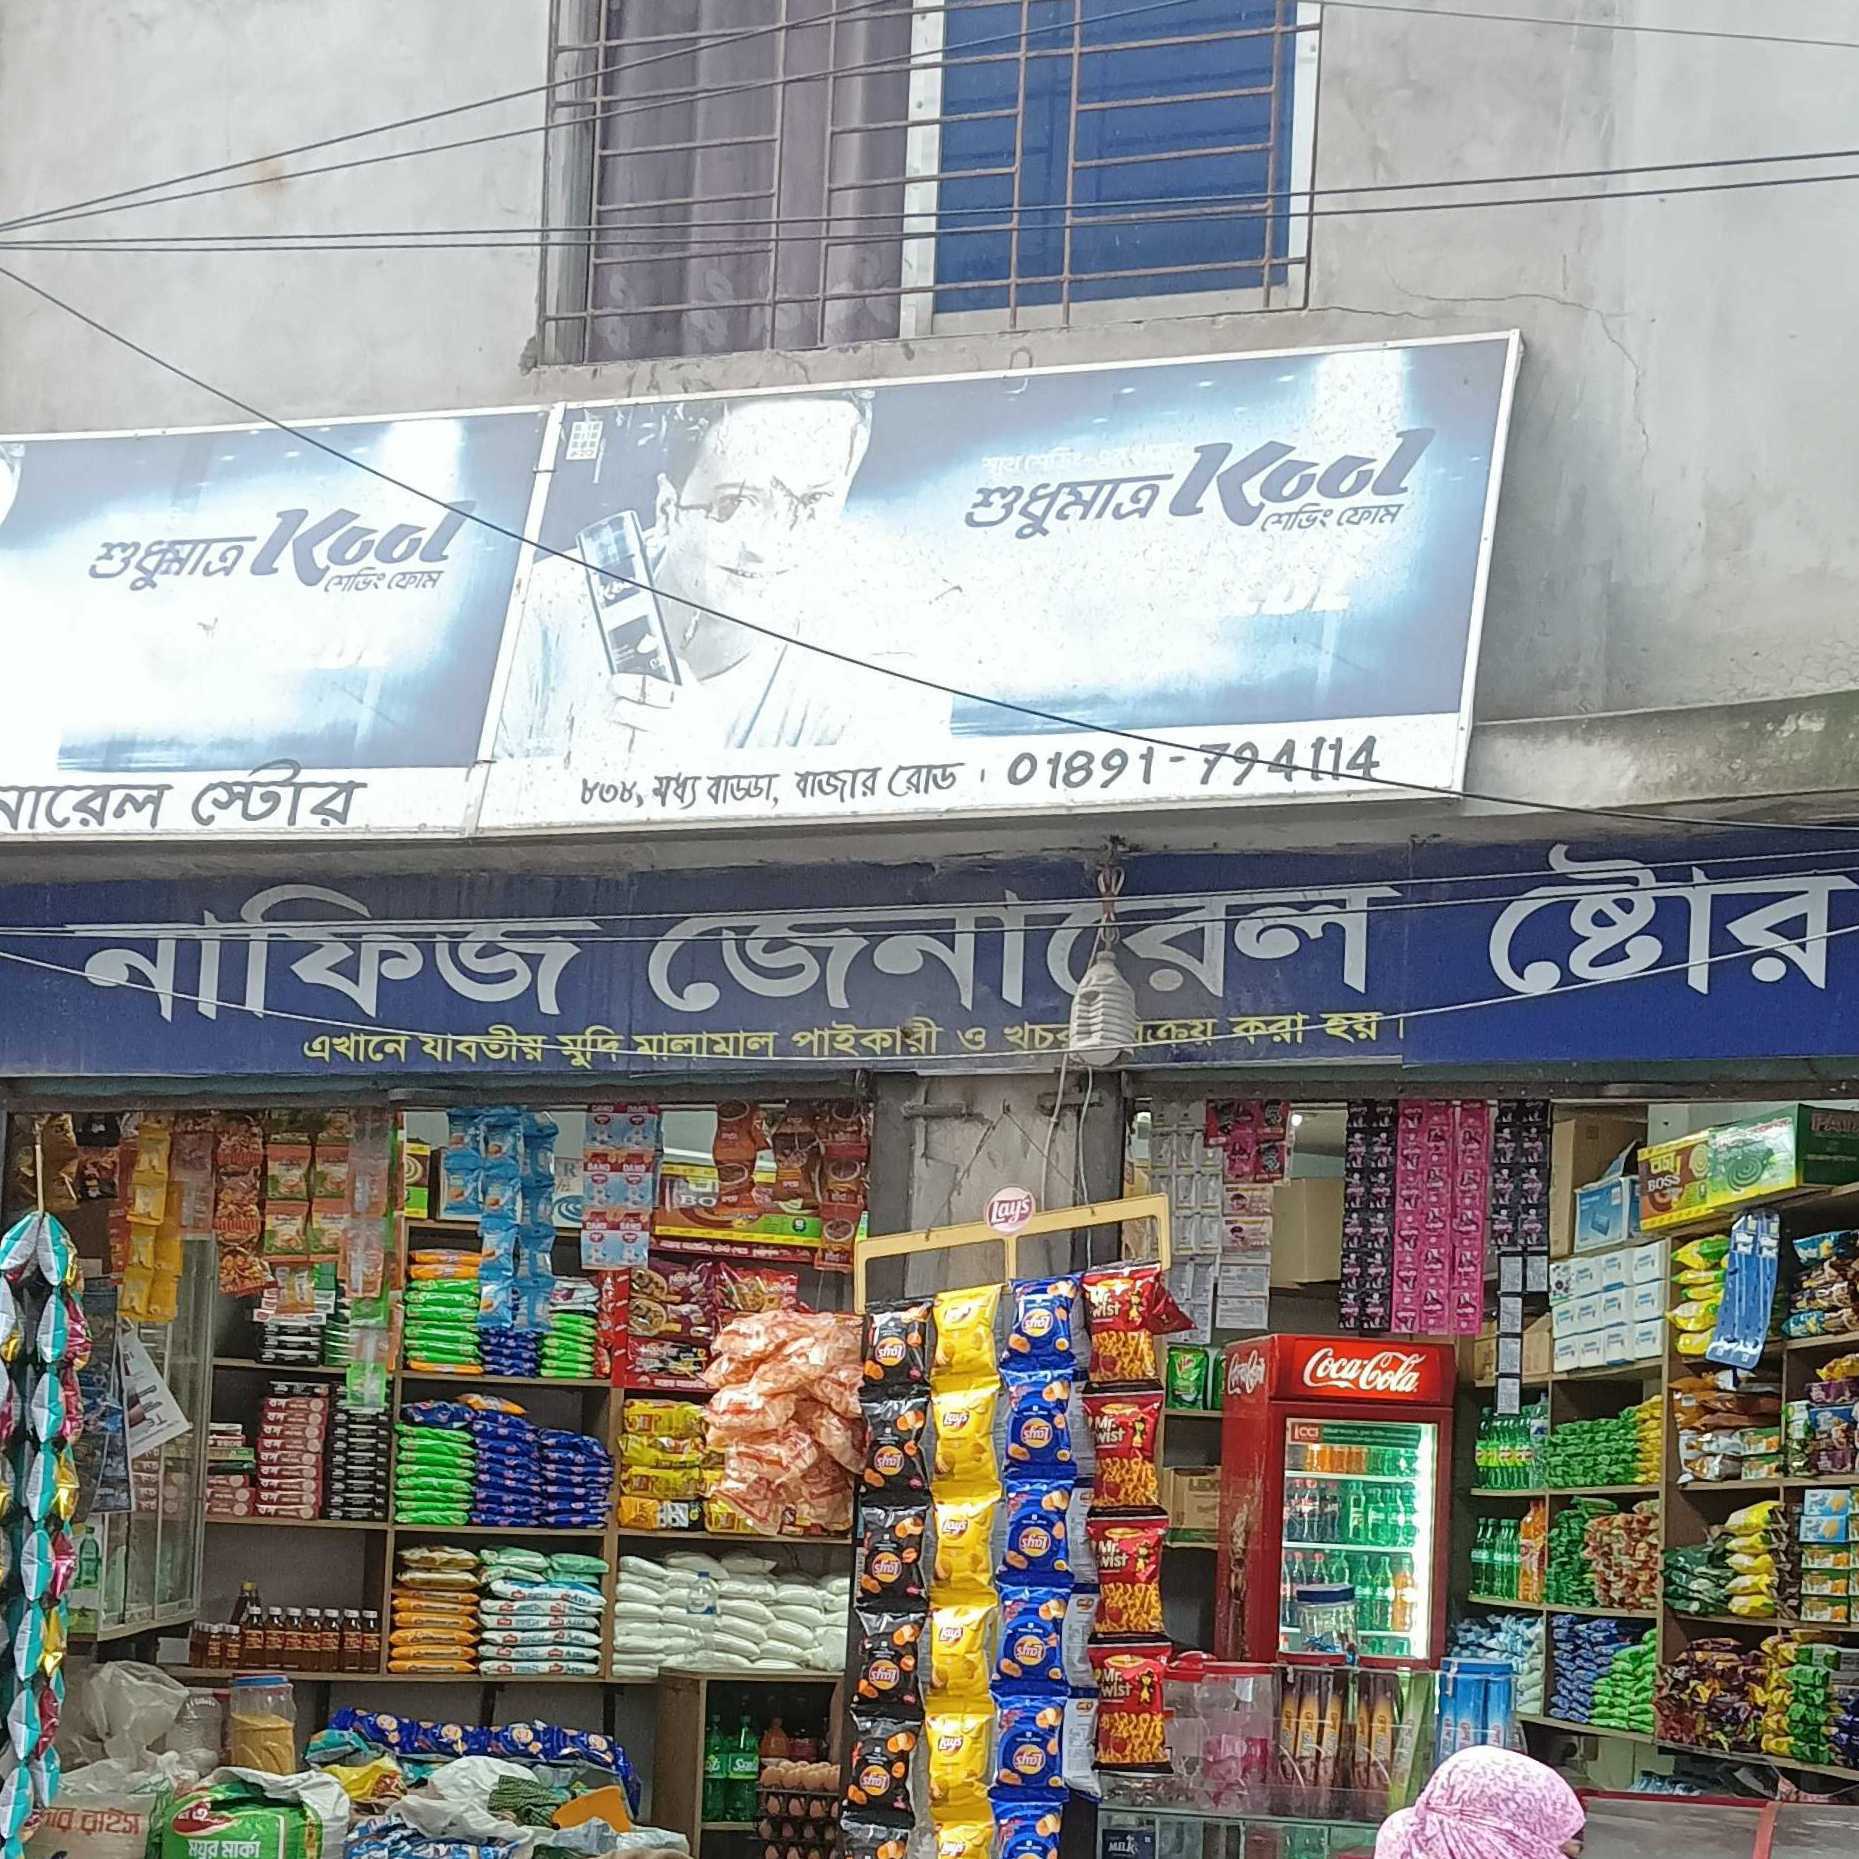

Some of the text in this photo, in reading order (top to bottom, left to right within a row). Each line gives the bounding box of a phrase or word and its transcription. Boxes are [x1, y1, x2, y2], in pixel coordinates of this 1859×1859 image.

[965, 474, 1174, 539] শুধুমাত্র
[1169, 428, 1435, 526] Kool
[250, 500, 476, 587] Kool
[795, 766, 882, 803] বাজার
[887, 763, 965, 797] রোড
[1007, 735, 1380, 789] 01891-794114
[65, 883, 602, 1023] নাফিজ
[648, 882, 1403, 1012] জেনারেল
[303, 1031, 412, 1064] এখানে
[632, 1030, 779, 1062] মালামাল
[792, 1017, 944, 1058] পাইকারী
[955, 1026, 987, 1052] ও
[1228, 1012, 1308, 1045] করা
[1092, 1303, 1121, 1318] wist
[1303, 1347, 1427, 1393] Coca-Cola
[1096, 1428, 1126, 1443] wist
[1100, 1552, 1130, 1568] wist
[1101, 1682, 1132, 1697] wist
